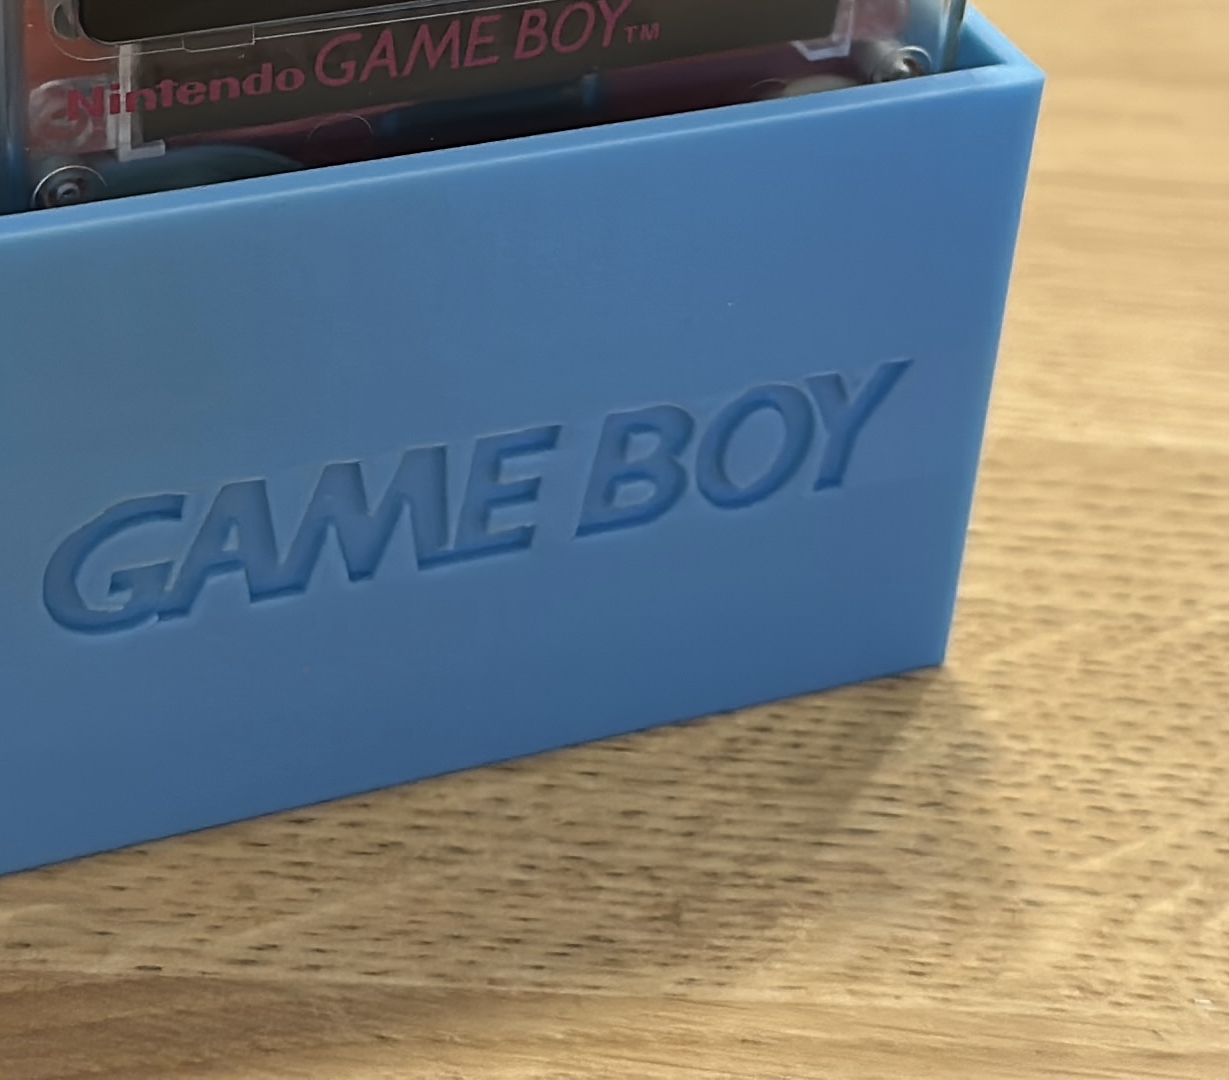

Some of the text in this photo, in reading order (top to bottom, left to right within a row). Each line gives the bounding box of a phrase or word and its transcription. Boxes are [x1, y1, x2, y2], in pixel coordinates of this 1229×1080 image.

[66, 62, 305, 120] Nintendo
[314, 14, 503, 87] GAME
[41, 358, 914, 637] GAME BOY
